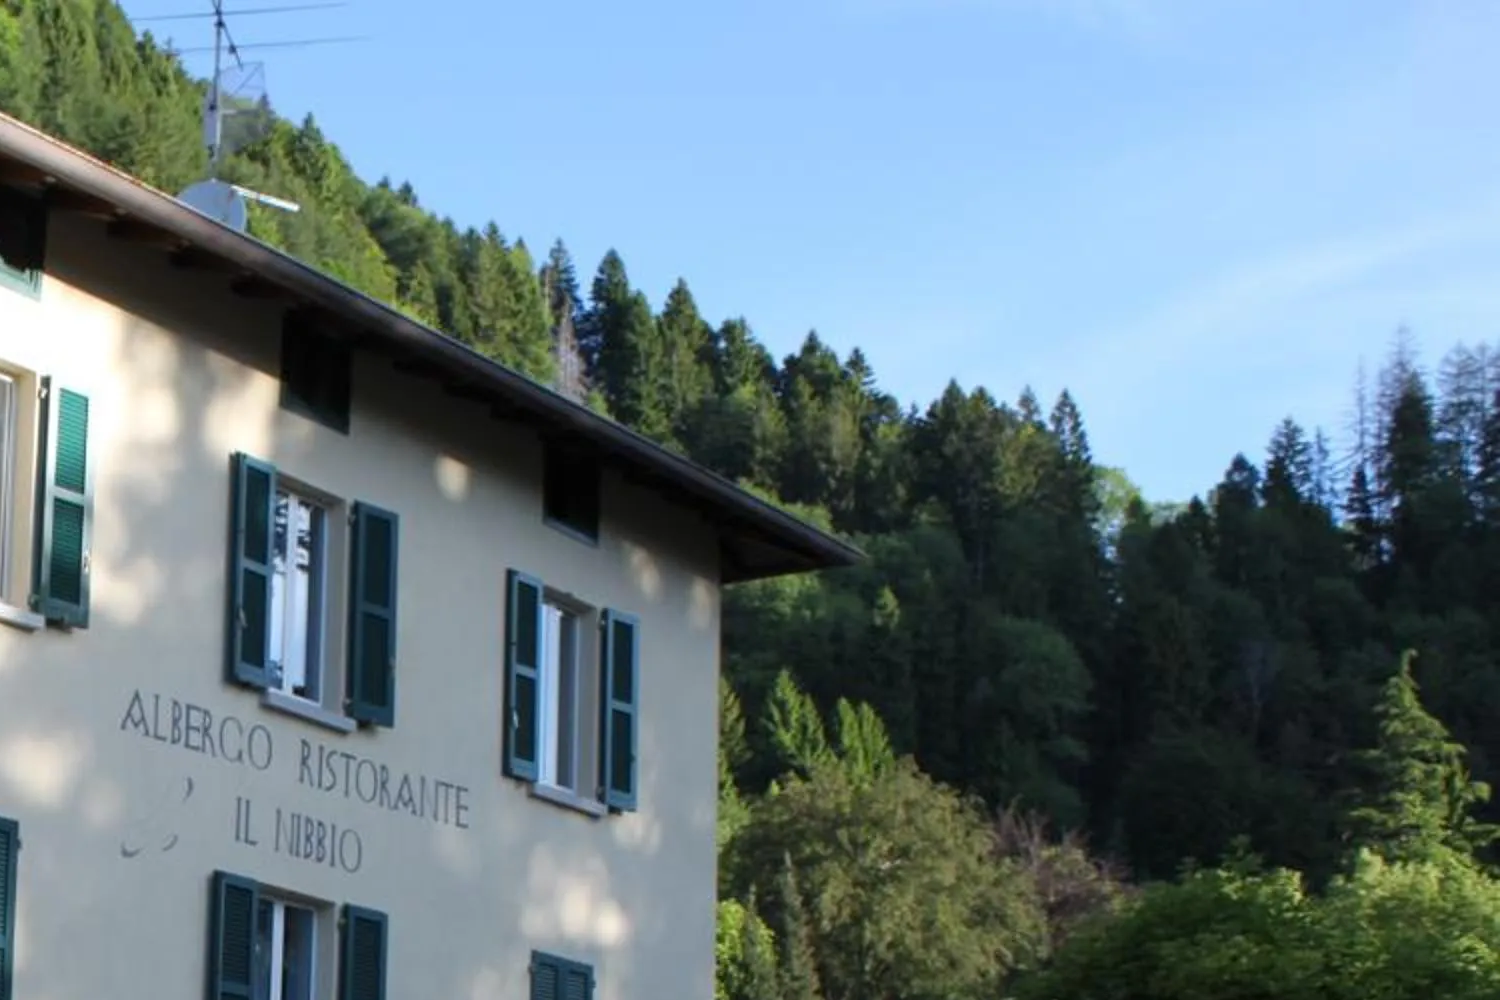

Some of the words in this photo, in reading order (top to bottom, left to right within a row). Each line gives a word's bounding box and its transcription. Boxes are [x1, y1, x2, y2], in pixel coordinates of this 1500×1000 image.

[120, 689, 273, 771] ALBERGO
[299, 737, 470, 829] RISTORANTE
[234, 796, 259, 847] IL
[274, 808, 363, 873] NIBBIO
